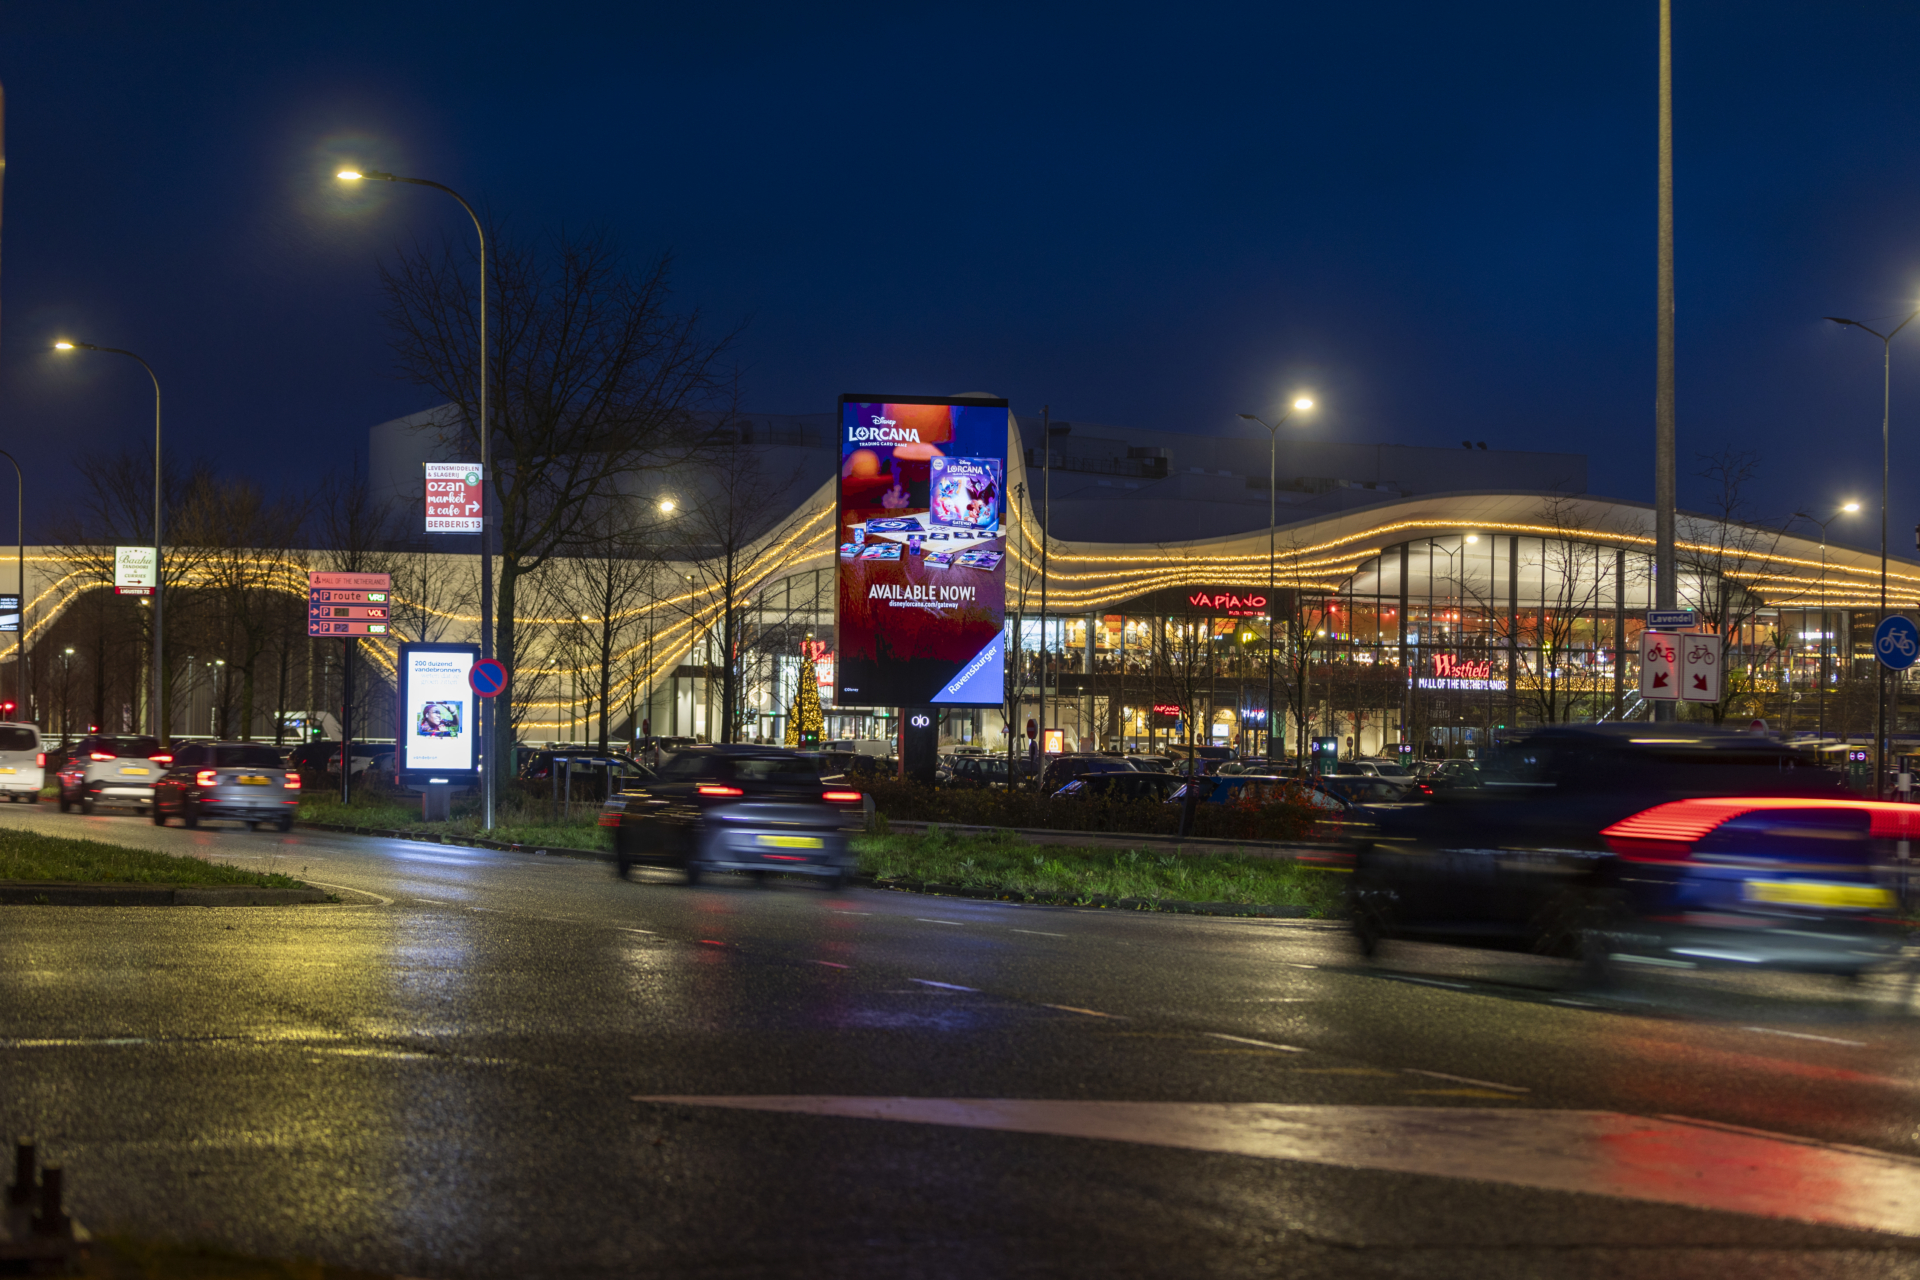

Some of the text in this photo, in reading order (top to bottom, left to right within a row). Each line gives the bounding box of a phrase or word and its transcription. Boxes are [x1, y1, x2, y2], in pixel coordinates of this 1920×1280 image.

[871, 415, 896, 427] Disney
[849, 426, 921, 444] LORCANA
[947, 465, 983, 475] LORCANA
[428, 482, 465, 492] ozan
[427, 491, 467, 503] market
[428, 506, 435, 515] &
[428, 520, 469, 528] BERBERIS
[333, 592, 361, 600] route
[869, 584, 976, 601] AVAILABLE NOW!
[889, 600, 958, 609] disneylorcana.com/gateway
[1651, 614, 1692, 622] Lavendel
[334, 624, 348, 632] P2
[948, 645, 997, 694] Ravensburger
[1433, 653, 1493, 677] Westfield
[1437, 678, 1446, 688] OF
[1447, 679, 1459, 689] THE
